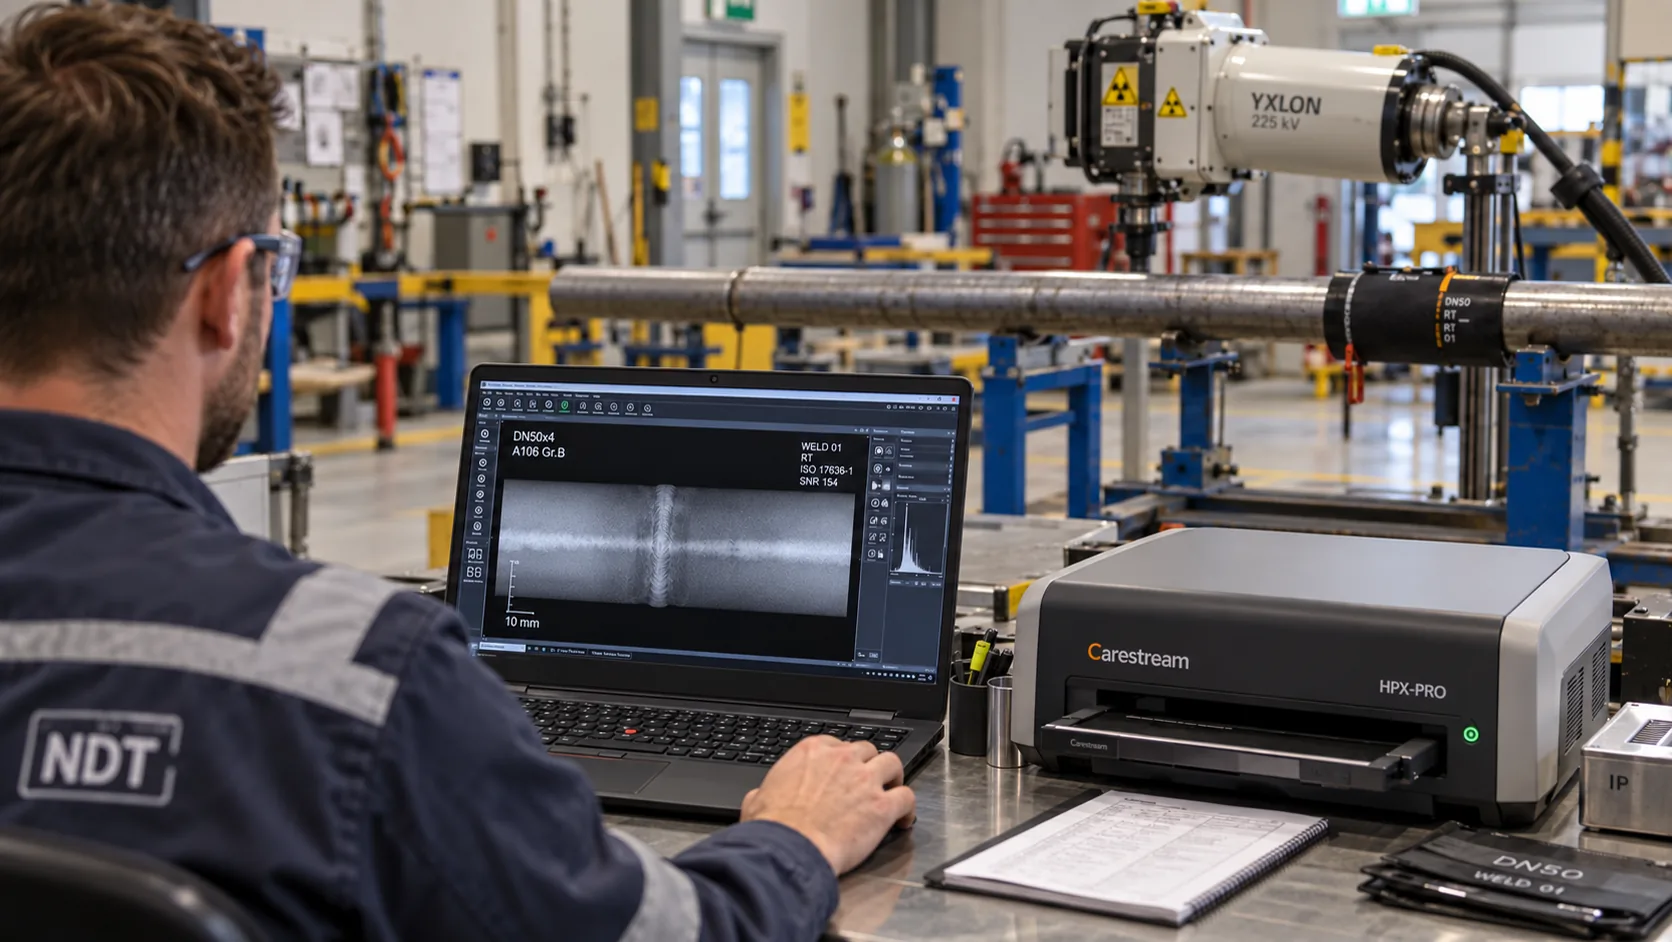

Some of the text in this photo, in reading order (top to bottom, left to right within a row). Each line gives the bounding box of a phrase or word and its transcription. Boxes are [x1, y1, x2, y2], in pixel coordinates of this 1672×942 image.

[1251, 91, 1323, 115] YXLON
[1251, 114, 1301, 131] 225 kV
[1444, 296, 1472, 307] DN50
[1443, 309, 1457, 320] RT
[1443, 322, 1457, 333] RT
[513, 430, 556, 443] DN50x4
[511, 445, 566, 459] A106 Gr.B
[801, 441, 842, 452] WELD 01
[800, 453, 814, 462] RT
[800, 464, 853, 476] ISO 17636-1
[799, 476, 838, 487] SNR 154
[505, 615, 540, 629] 10 mm
[1087, 642, 1190, 670] Carestream
[1379, 679, 1447, 700] HPX-PRO
[1069, 738, 1109, 751] Carestream
[39, 730, 162, 790] NDT
[1609, 773, 1629, 791] IP
[1492, 855, 1584, 880] DN50
[1473, 870, 1532, 888] WELD
